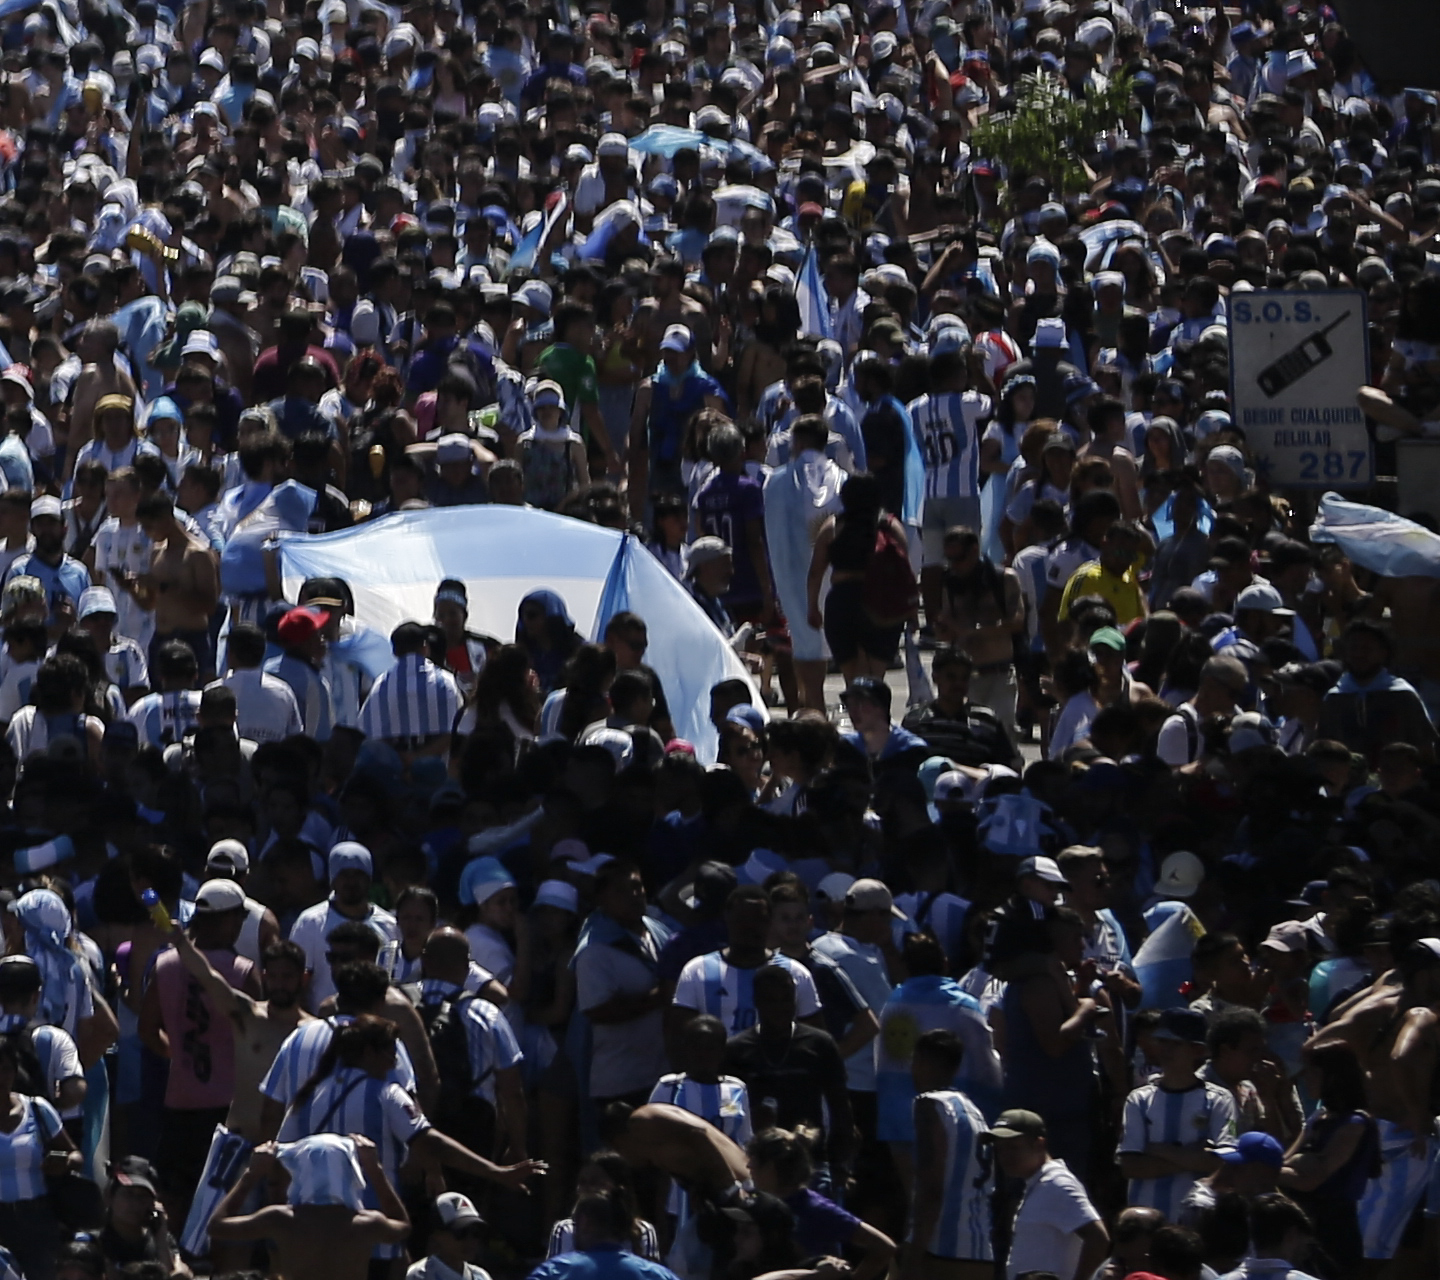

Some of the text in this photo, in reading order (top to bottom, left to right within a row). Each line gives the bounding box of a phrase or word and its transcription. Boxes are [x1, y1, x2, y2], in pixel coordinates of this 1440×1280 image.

[1234, 301, 1321, 323] S.O.S.
[1243, 407, 1285, 425] DESDE
[1298, 449, 1367, 480] 287
